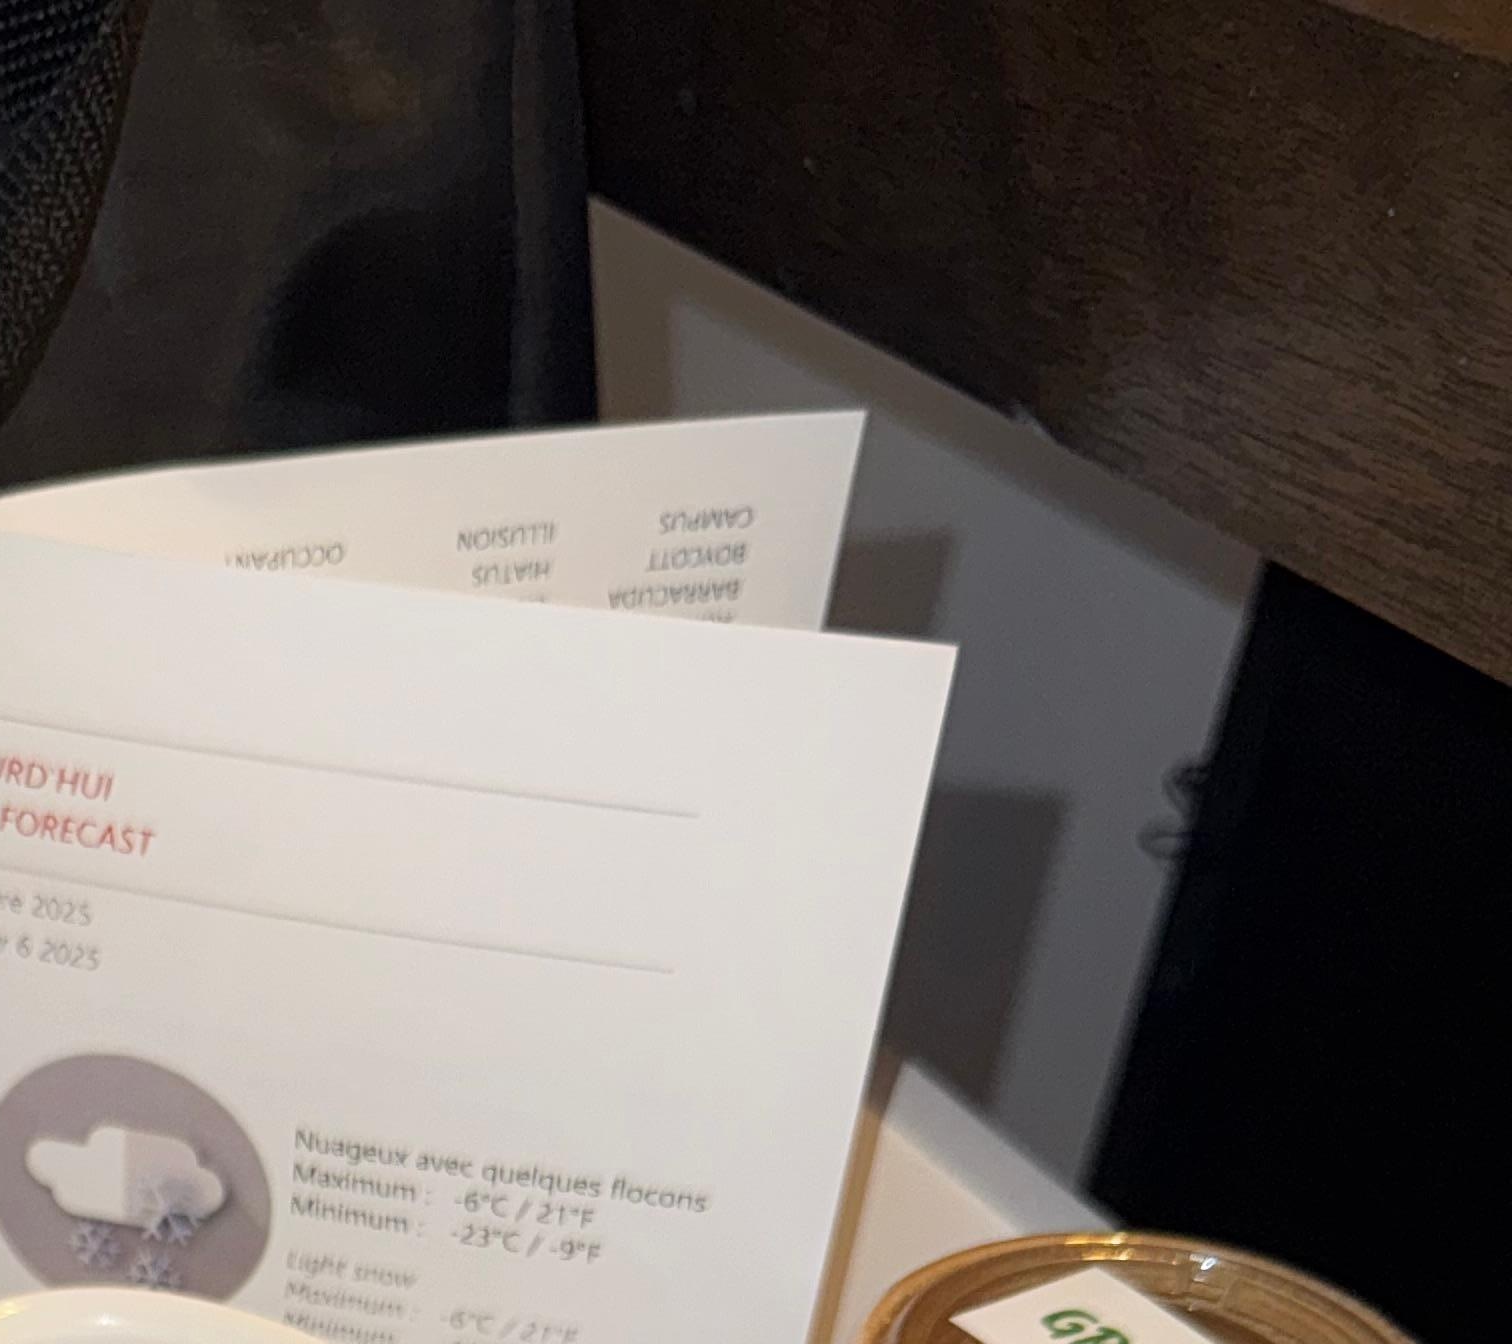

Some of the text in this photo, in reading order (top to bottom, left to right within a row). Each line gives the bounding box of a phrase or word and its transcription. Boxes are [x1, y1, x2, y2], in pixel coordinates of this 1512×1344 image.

[658, 504, 756, 534] CAMPUS
[456, 520, 559, 553] ILLUSION
[224, 541, 345, 572] OCCUPAN
[471, 559, 552, 588] HIATUS
[645, 542, 749, 573] BOYCOTT
[607, 577, 746, 612] BARRACUDA
[0, 804, 158, 857] FORECAST
[32, 895, 92, 927] 2025
[16, 936, 32, 958] 6
[39, 939, 102, 972] 2025
[295, 1128, 712, 1214] Nuageux avec quelques flocons
[292, 1163, 416, 1202] Maximum
[455, 1190, 508, 1218] -6°C
[536, 1201, 595, 1228] 21°F
[290, 1195, 409, 1233] Minimum
[450, 1224, 520, 1253] -23°C
[550, 1237, 602, 1264] -9°F
